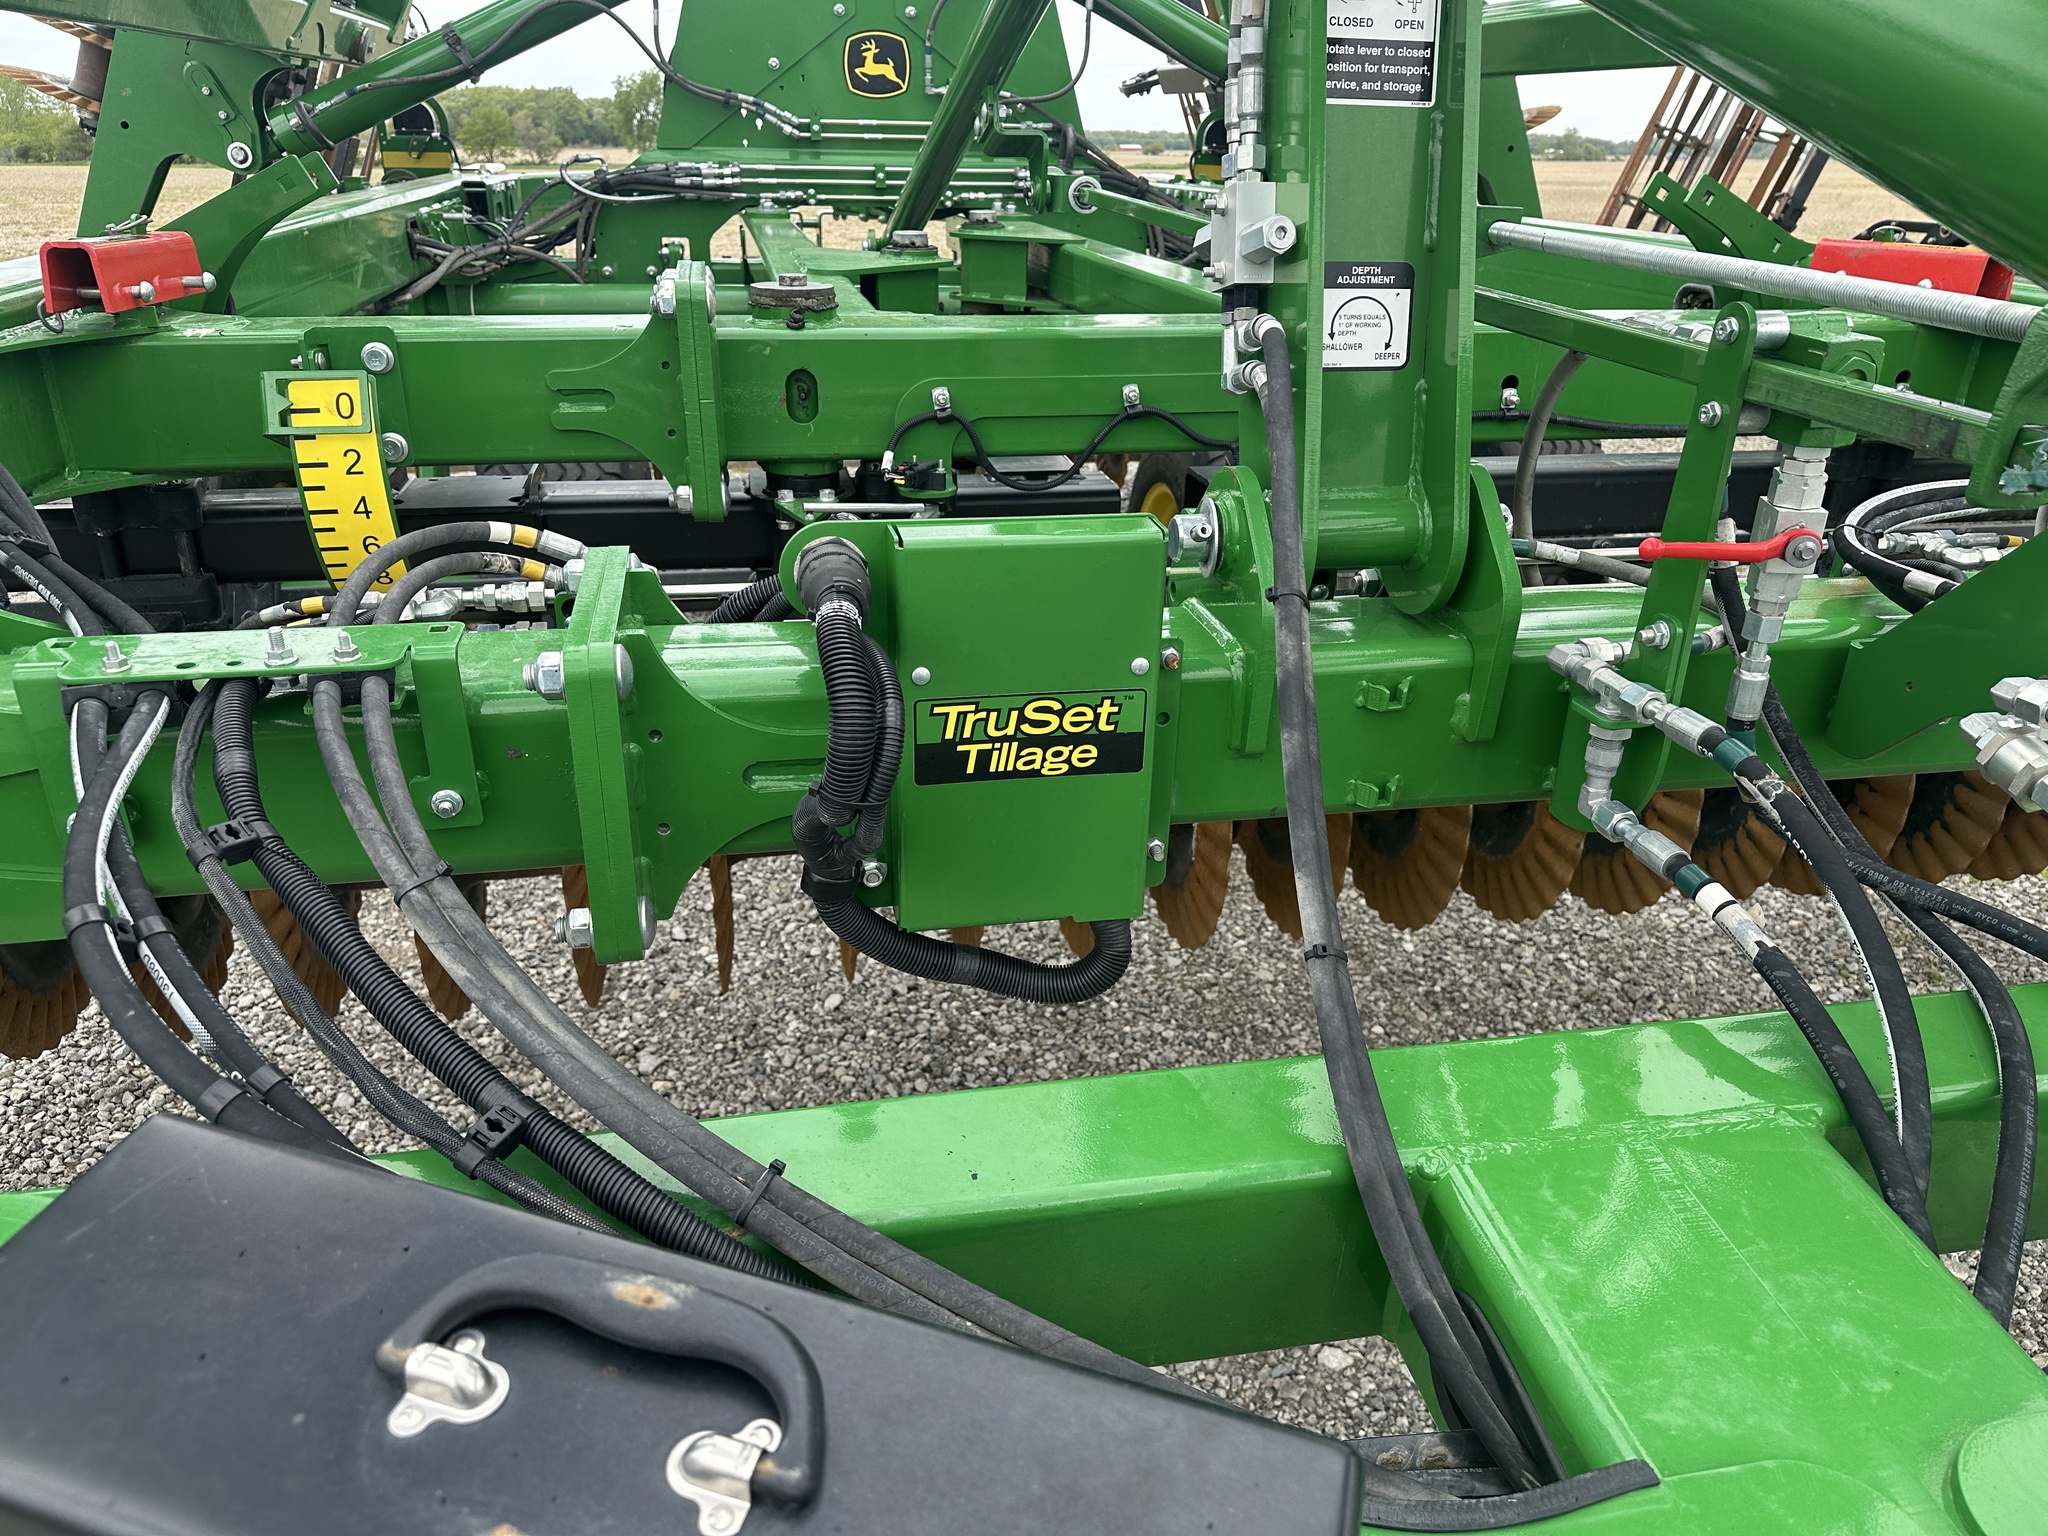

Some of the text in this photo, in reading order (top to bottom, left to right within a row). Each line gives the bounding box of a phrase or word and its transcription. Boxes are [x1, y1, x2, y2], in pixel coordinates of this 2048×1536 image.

[1329, 16, 1374, 28] CLOSED
[1394, 19, 1425, 30] OPEN
[1357, 45, 1382, 56] lever
[1384, 48, 1395, 56] to
[1397, 47, 1431, 58] closed
[1326, 62, 1431, 76] osition for transport,
[1326, 79, 1424, 94] ervice, and storage.
[1352, 267, 1381, 275] DEPTH
[1337, 276, 1396, 284] ADJUSTMENT
[1322, 343, 1363, 351] SHALLOWER
[335, 392, 355, 420] 0
[343, 448, 364, 475] 2
[353, 495, 373, 519] 4
[362, 535, 382, 555] 6
[932, 698, 1120, 741] TruSet
[956, 741, 1098, 776] Tillage
[1975, 911, 1999, 925] RYCO
